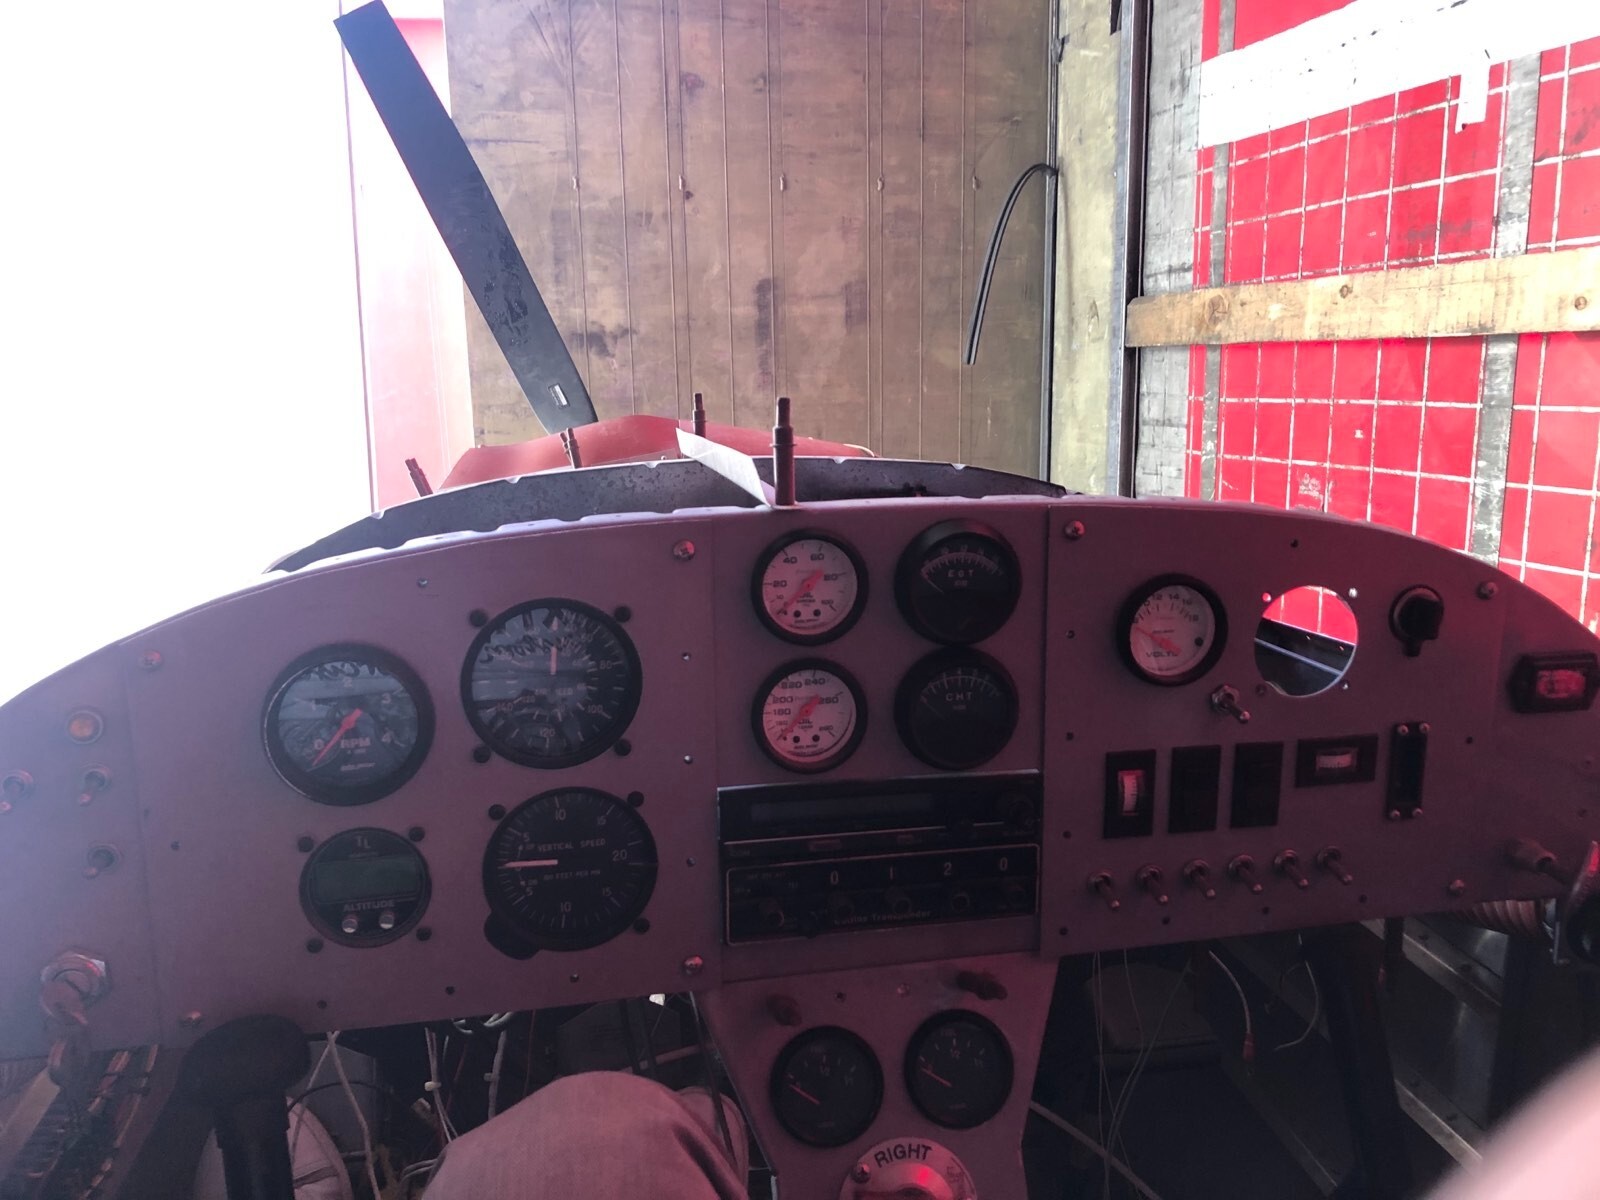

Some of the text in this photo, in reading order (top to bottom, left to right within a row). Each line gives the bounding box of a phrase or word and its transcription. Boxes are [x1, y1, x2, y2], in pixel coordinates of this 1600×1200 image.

[783, 556, 797, 564] 40
[343, 678, 353, 688] 2
[381, 693, 392, 704] 3
[340, 737, 370, 748] RPM
[555, 809, 566, 820] 10
[355, 835, 371, 849] TL
[523, 833, 530, 842] 5
[538, 838, 606, 852] VERTICAL SPEED
[612, 849, 627, 862] 20
[829, 870, 839, 885] 0
[944, 862, 952, 876] 2
[999, 857, 1008, 871] 0
[343, 900, 395, 912] ALTITUDE
[560, 902, 571, 912] 10
[874, 1143, 932, 1168] RIGHT
